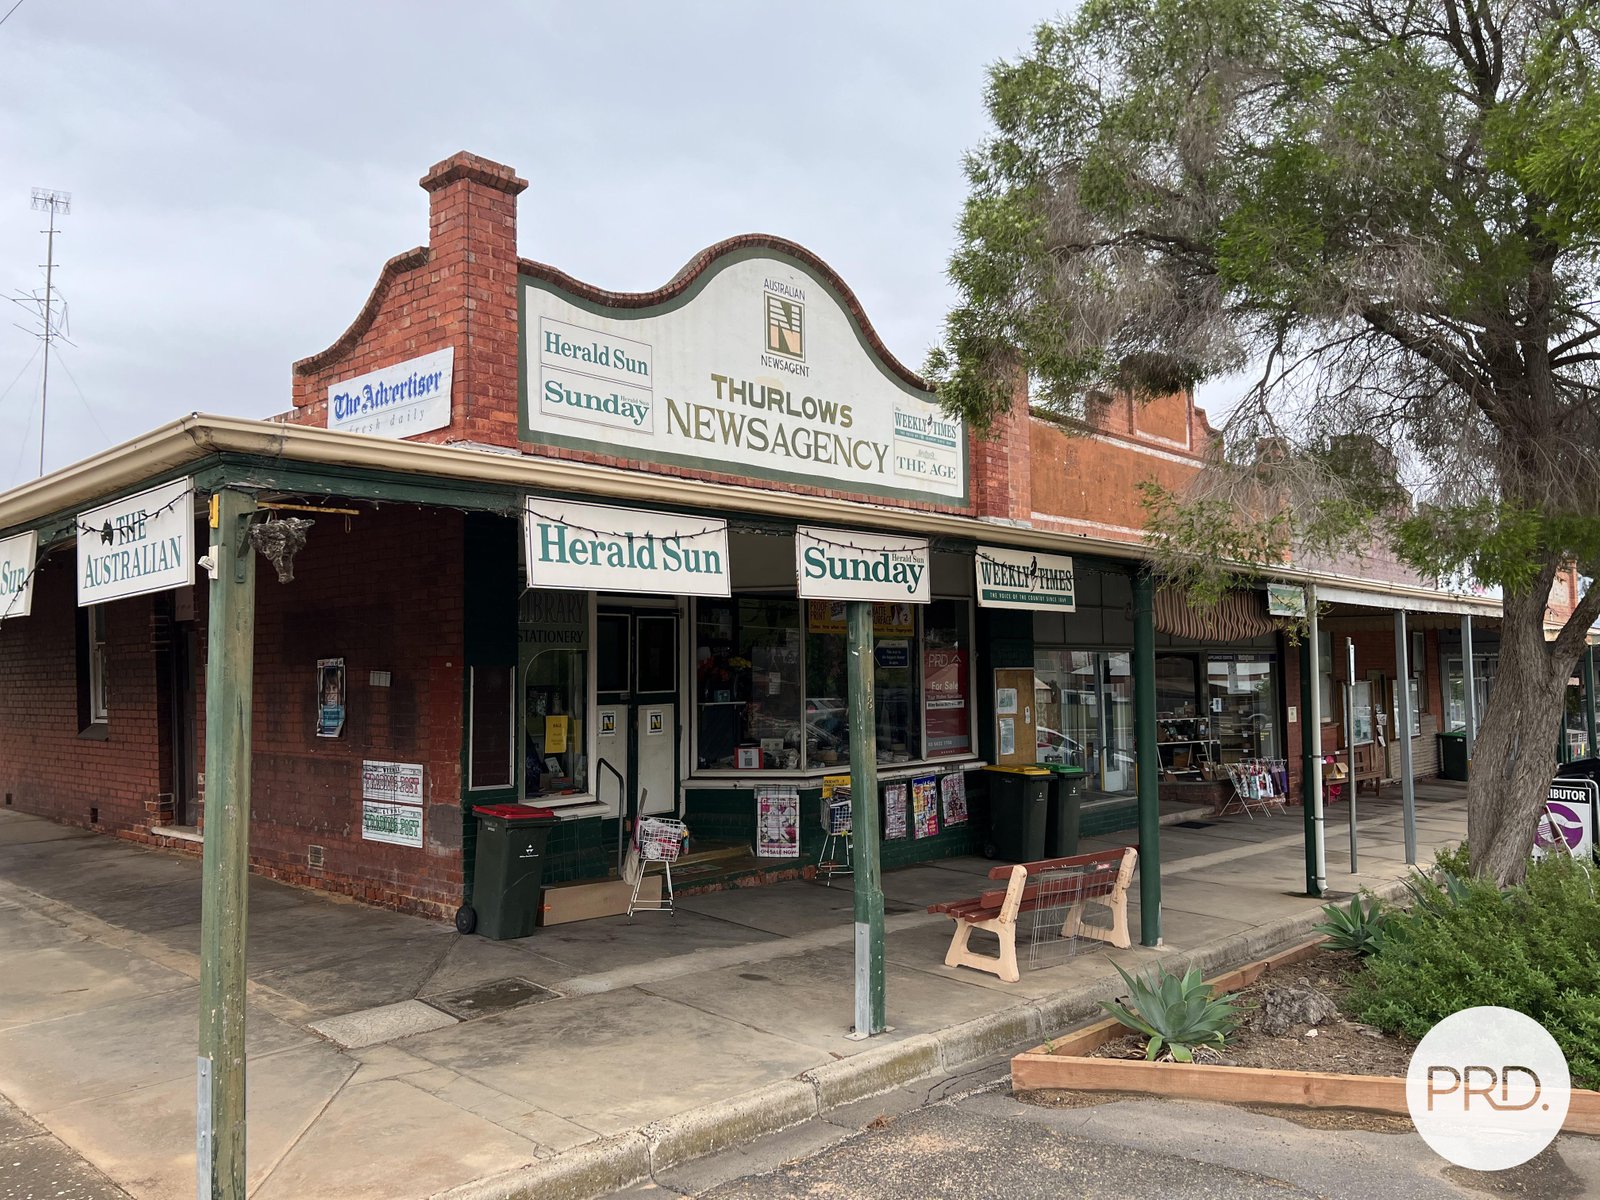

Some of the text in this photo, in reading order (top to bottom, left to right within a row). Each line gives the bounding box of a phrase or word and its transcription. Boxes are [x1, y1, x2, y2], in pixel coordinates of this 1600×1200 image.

[764, 278, 805, 300] AUSTRALIAN
[544, 331, 649, 376] Herald Sun
[761, 355, 810, 377] NEWSAGENT
[334, 371, 443, 420] The Advertiser
[544, 380, 650, 426] Sunday
[711, 373, 853, 429] THURLOWS
[389, 408, 425, 427] daily
[894, 412, 928, 433] WEEKLY
[932, 421, 957, 440] TIMES
[664, 397, 889, 474] NEWSAGENCY
[896, 455, 956, 479] THE AGE
[116, 509, 147, 547] THE
[83, 535, 182, 590] AUSTRALIAN
[536, 523, 723, 575] Herald Sun
[891, 553, 925, 564] Herald Sun
[0, 561, 26, 596] Sun
[804, 547, 925, 594] Sunday
[980, 561, 1073, 591] WEEKLY TIMES
[517, 630, 584, 643] STATIONERY
[931, 681, 958, 690] For Sale
[1547, 788, 1586, 801] IBUTOR
